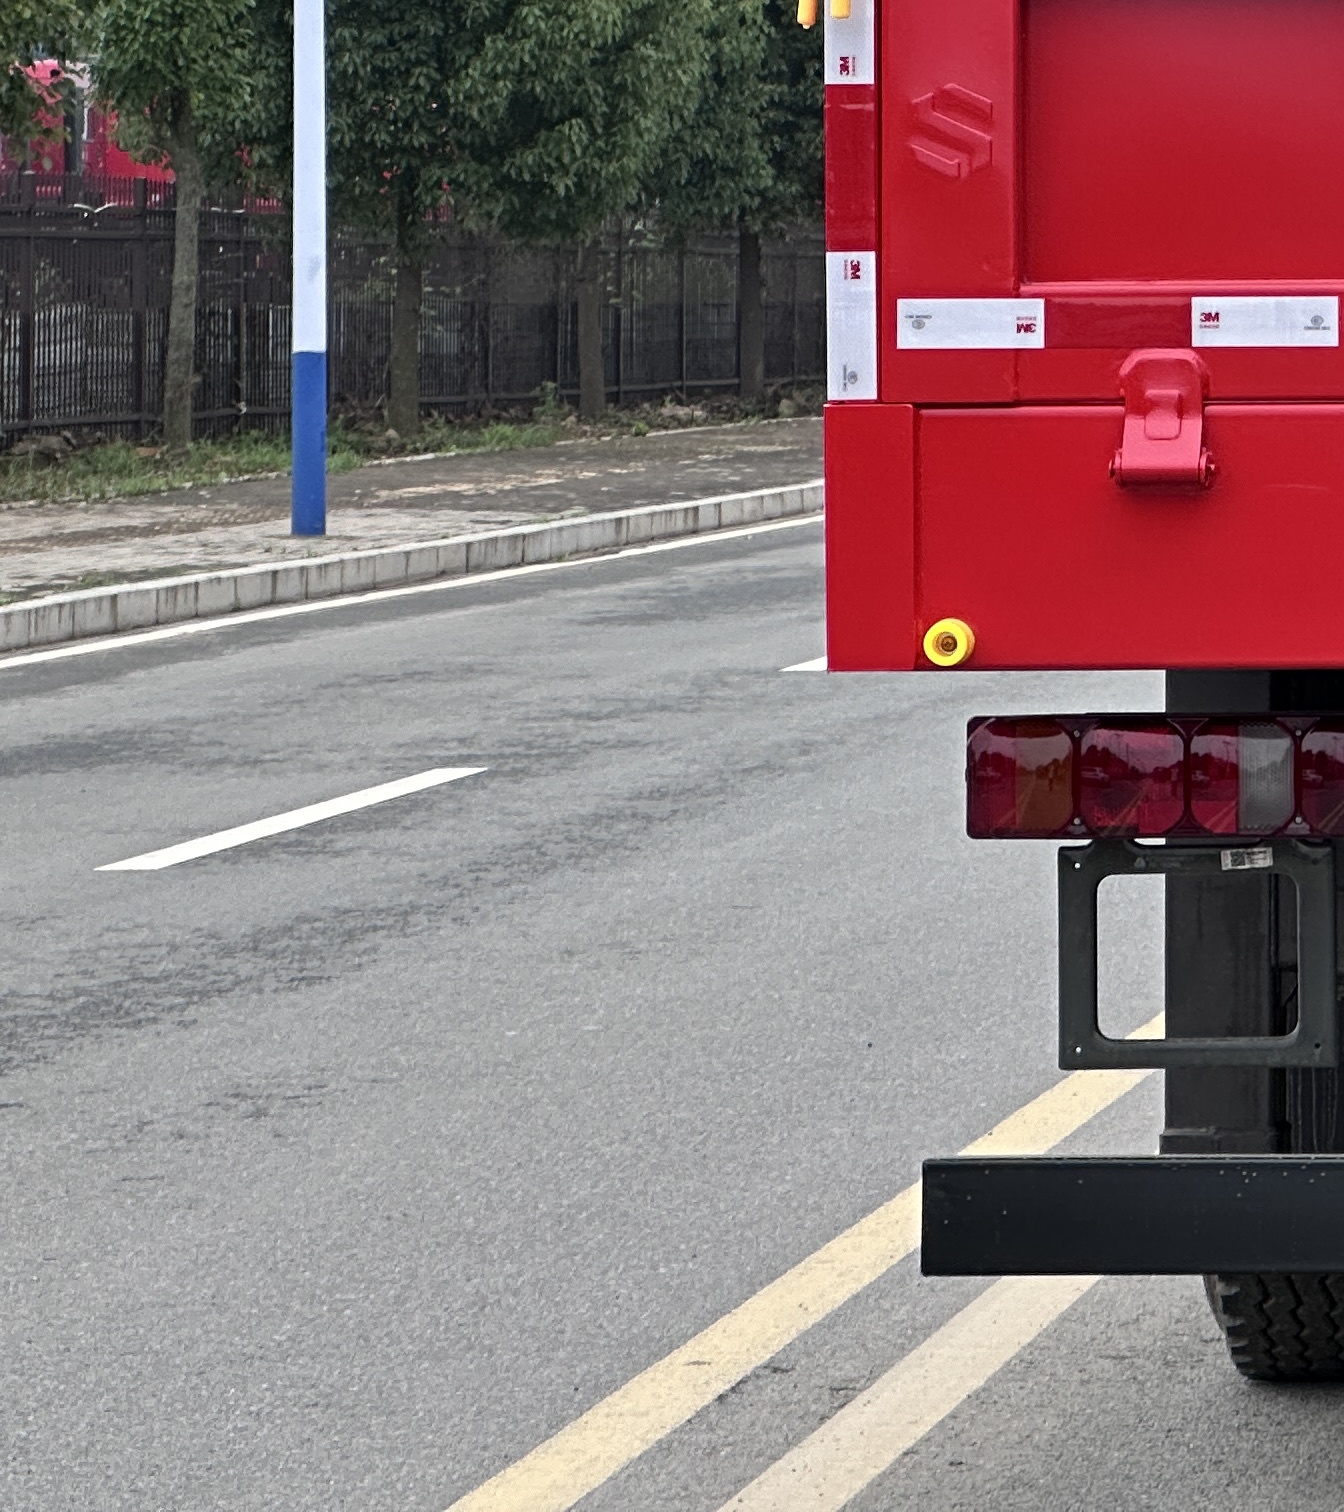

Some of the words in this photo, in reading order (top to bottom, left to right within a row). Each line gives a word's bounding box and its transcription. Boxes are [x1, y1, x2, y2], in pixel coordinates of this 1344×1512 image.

[839, 55, 850, 76] 3M
[850, 261, 861, 281] 3M
[1198, 311, 1220, 323] 3M
[1016, 322, 1038, 335] 3M
